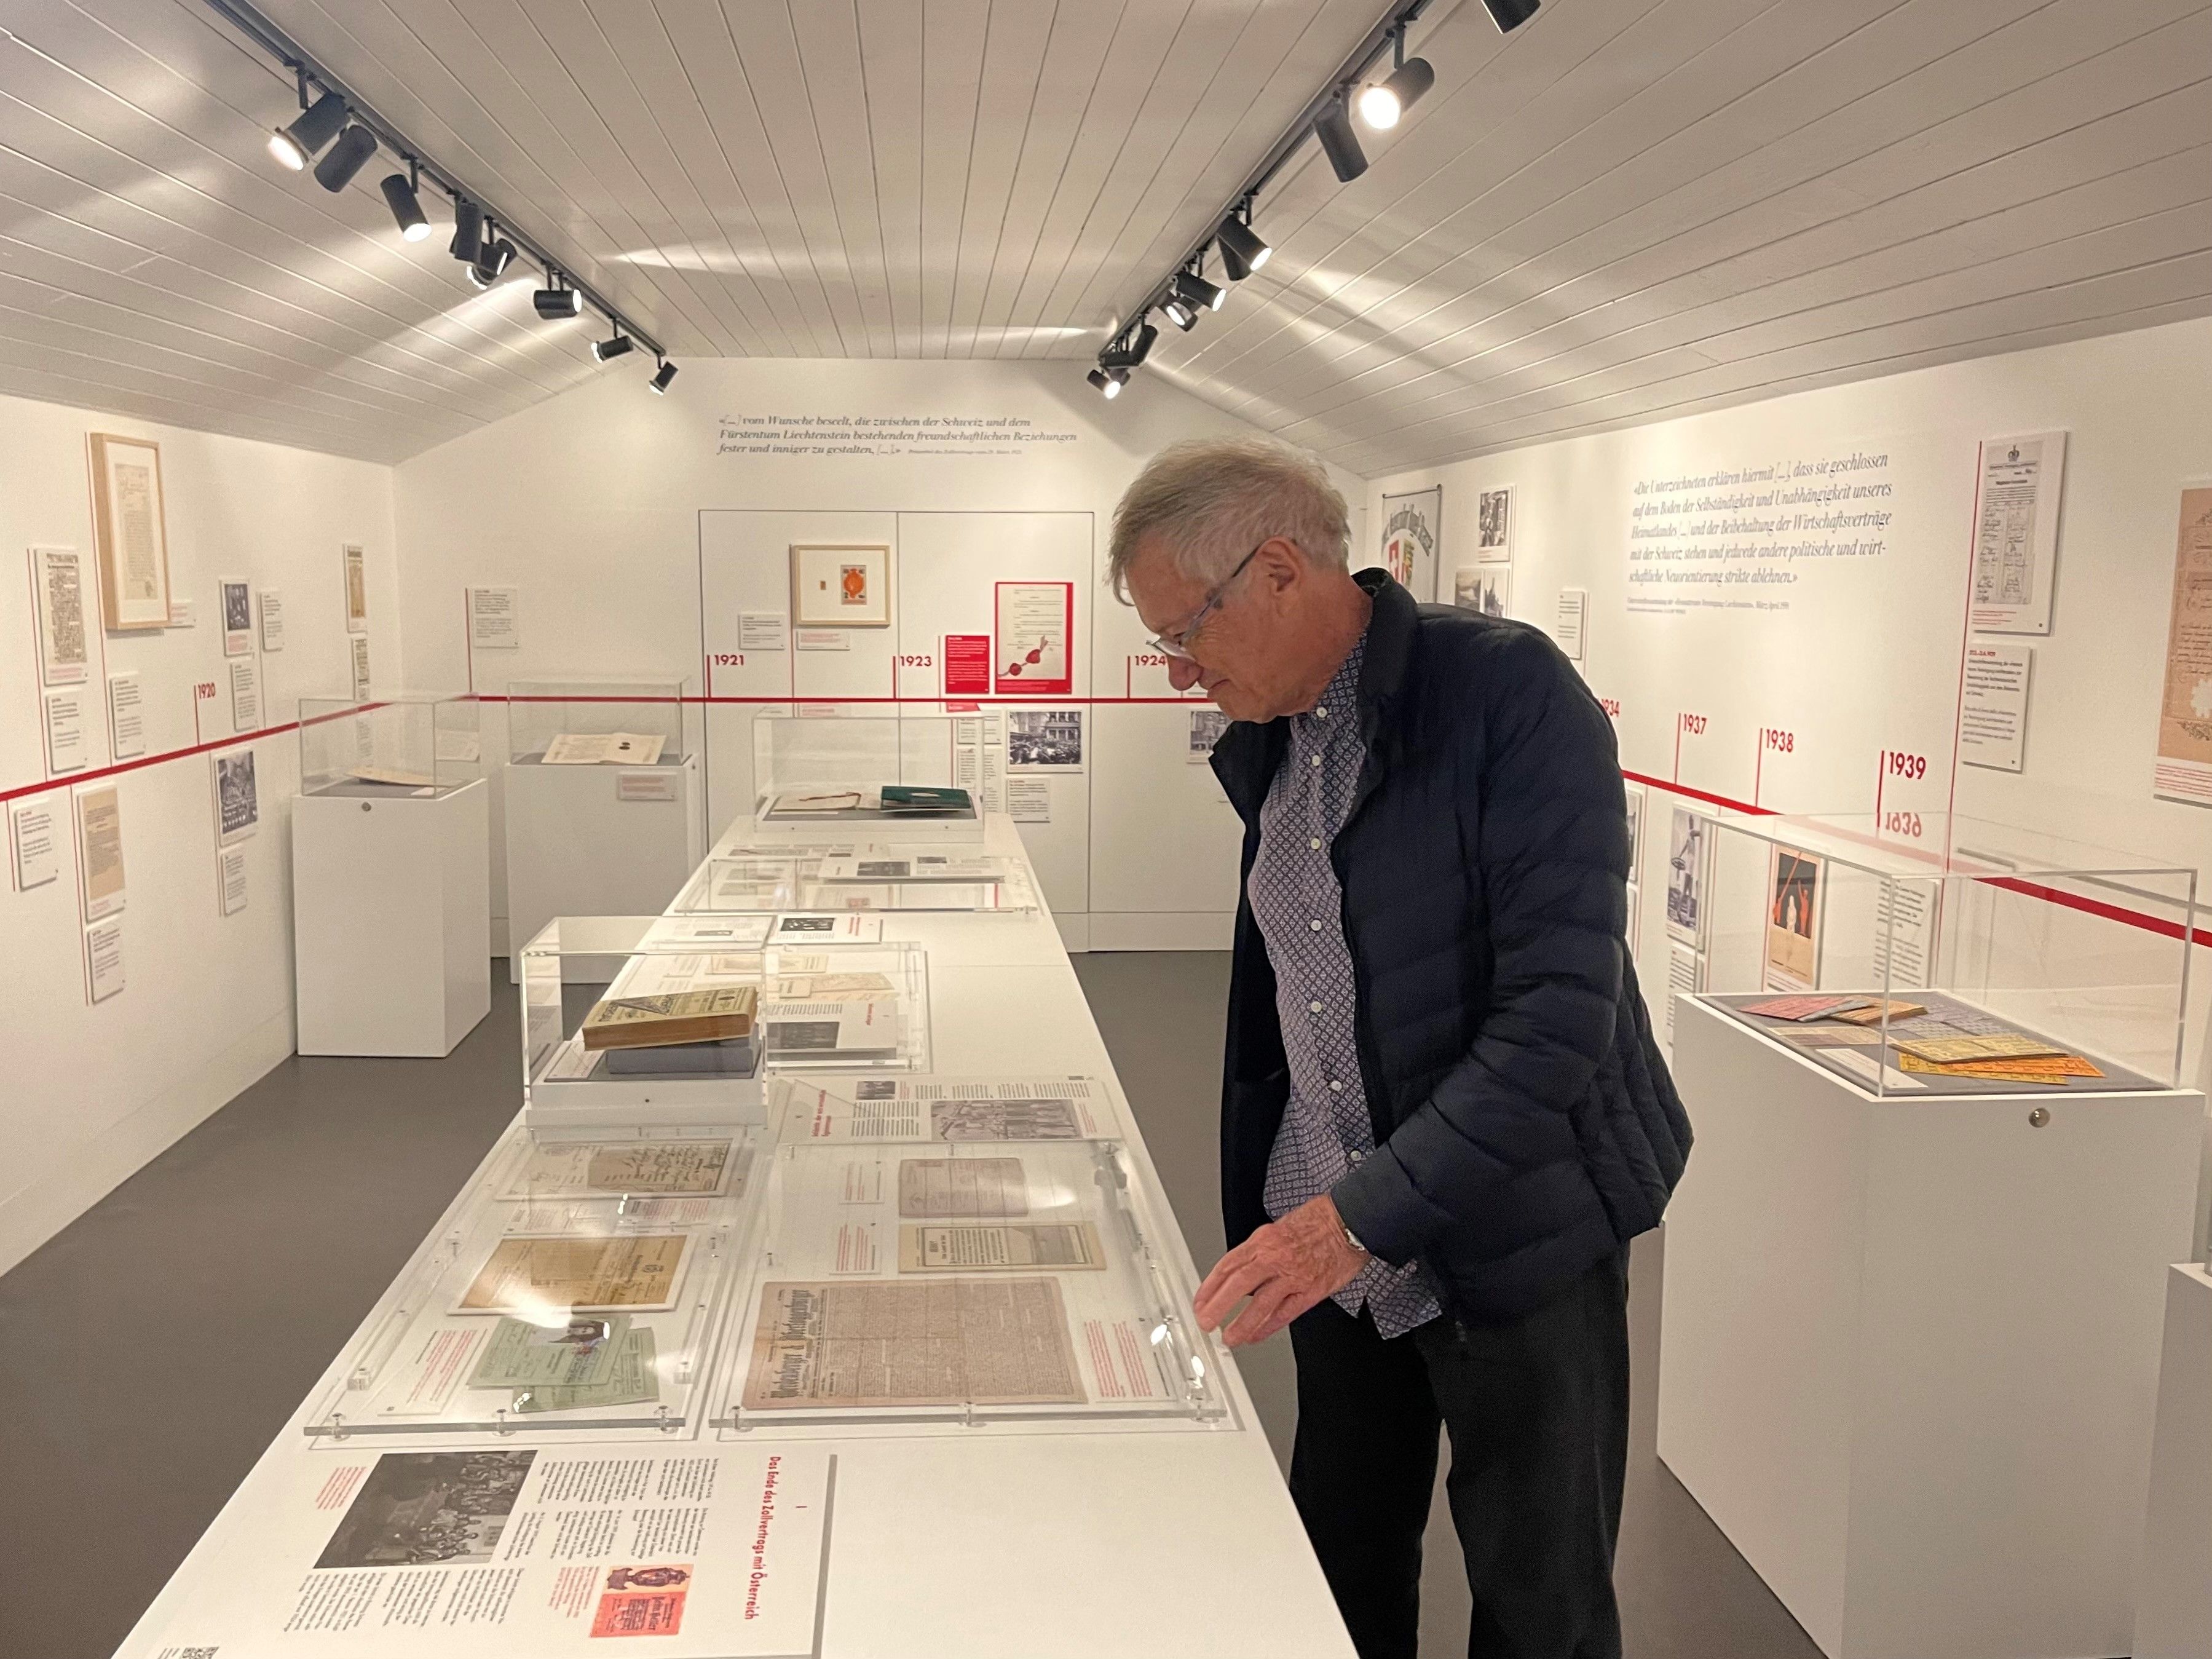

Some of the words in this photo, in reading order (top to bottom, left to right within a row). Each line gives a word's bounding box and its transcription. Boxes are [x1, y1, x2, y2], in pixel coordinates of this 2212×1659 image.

[768, 416, 815, 425] Wunsche
[855, 417, 871, 426] die
[874, 417, 920, 426] zwischen
[922, 417, 939, 426] der
[941, 418, 983, 427] Schweiz
[986, 418, 1007, 427] und
[1008, 418, 1030, 427] dem
[720, 429, 780, 438] Fürstentum
[783, 430, 850, 439] Liechtenstein
[853, 430, 914, 440] bestehenden
[913, 430, 1011, 443] freundschaftlichen
[1014, 431, 1077, 443] Beziehungen
[716, 443, 748, 455] fester
[749, 444, 770, 453] und
[772, 444, 810, 456] inniger
[826, 445, 874, 456] gestalten,
[1650, 475, 1706, 494] Unterzeichneten
[1707, 469, 1740, 487] erklären
[1742, 465, 1774, 483] hiermit
[1793, 461, 1814, 477] dass
[1815, 457, 1829, 475] sie
[1828, 453, 1888, 478] geschlossen
[1633, 502, 1646, 521] auf
[1645, 502, 1659, 516] dem
[1660, 500, 1681, 515] Boden
[1683, 498, 1695, 513] der
[1696, 493, 1755, 513] Selbständigkeit
[1756, 490, 1774, 507] und
[1776, 483, 1851, 507] Unabhängigkeit
[1852, 483, 1893, 498] unseres
[1691, 520, 1706, 536] und
[1706, 520, 1720, 535] der
[1721, 517, 1775, 537] Beibehaltung
[1776, 515, 1791, 531] der
[1793, 510, 1892, 534] Wirtschaftsverträge
[1630, 547, 1643, 560] mit
[1643, 546, 1654, 560] der
[1655, 545, 1683, 560] Schweiz
[1684, 545, 1707, 560] stehen
[1708, 544, 1724, 559] und
[1758, 542, 1787, 558] andere
[1788, 539, 1835, 563] politische
[1836, 539, 1858, 556] und
[1859, 539, 1886, 556] wirt-
[1666, 569, 1723, 587] Neuorientierung
[1724, 568, 1750, 583] strikte
[714, 655, 744, 665] 1921
[900, 655, 932, 667] 1923
[1135, 655, 1166, 665] 1924
[198, 682, 216, 699] 1920
[1683, 713, 1707, 735] 1937
[1766, 729, 1794, 753] 1938
[1889, 751, 1927, 780] 1939
[768, 1455, 781, 1470] Das
[765, 1471, 779, 1489] Ende
[763, 1490, 777, 1503] des
[752, 1505, 775, 1554] Zollvertrags
[753, 1556, 767, 1570] mit
[745, 1572, 768, 1620] Österreich
